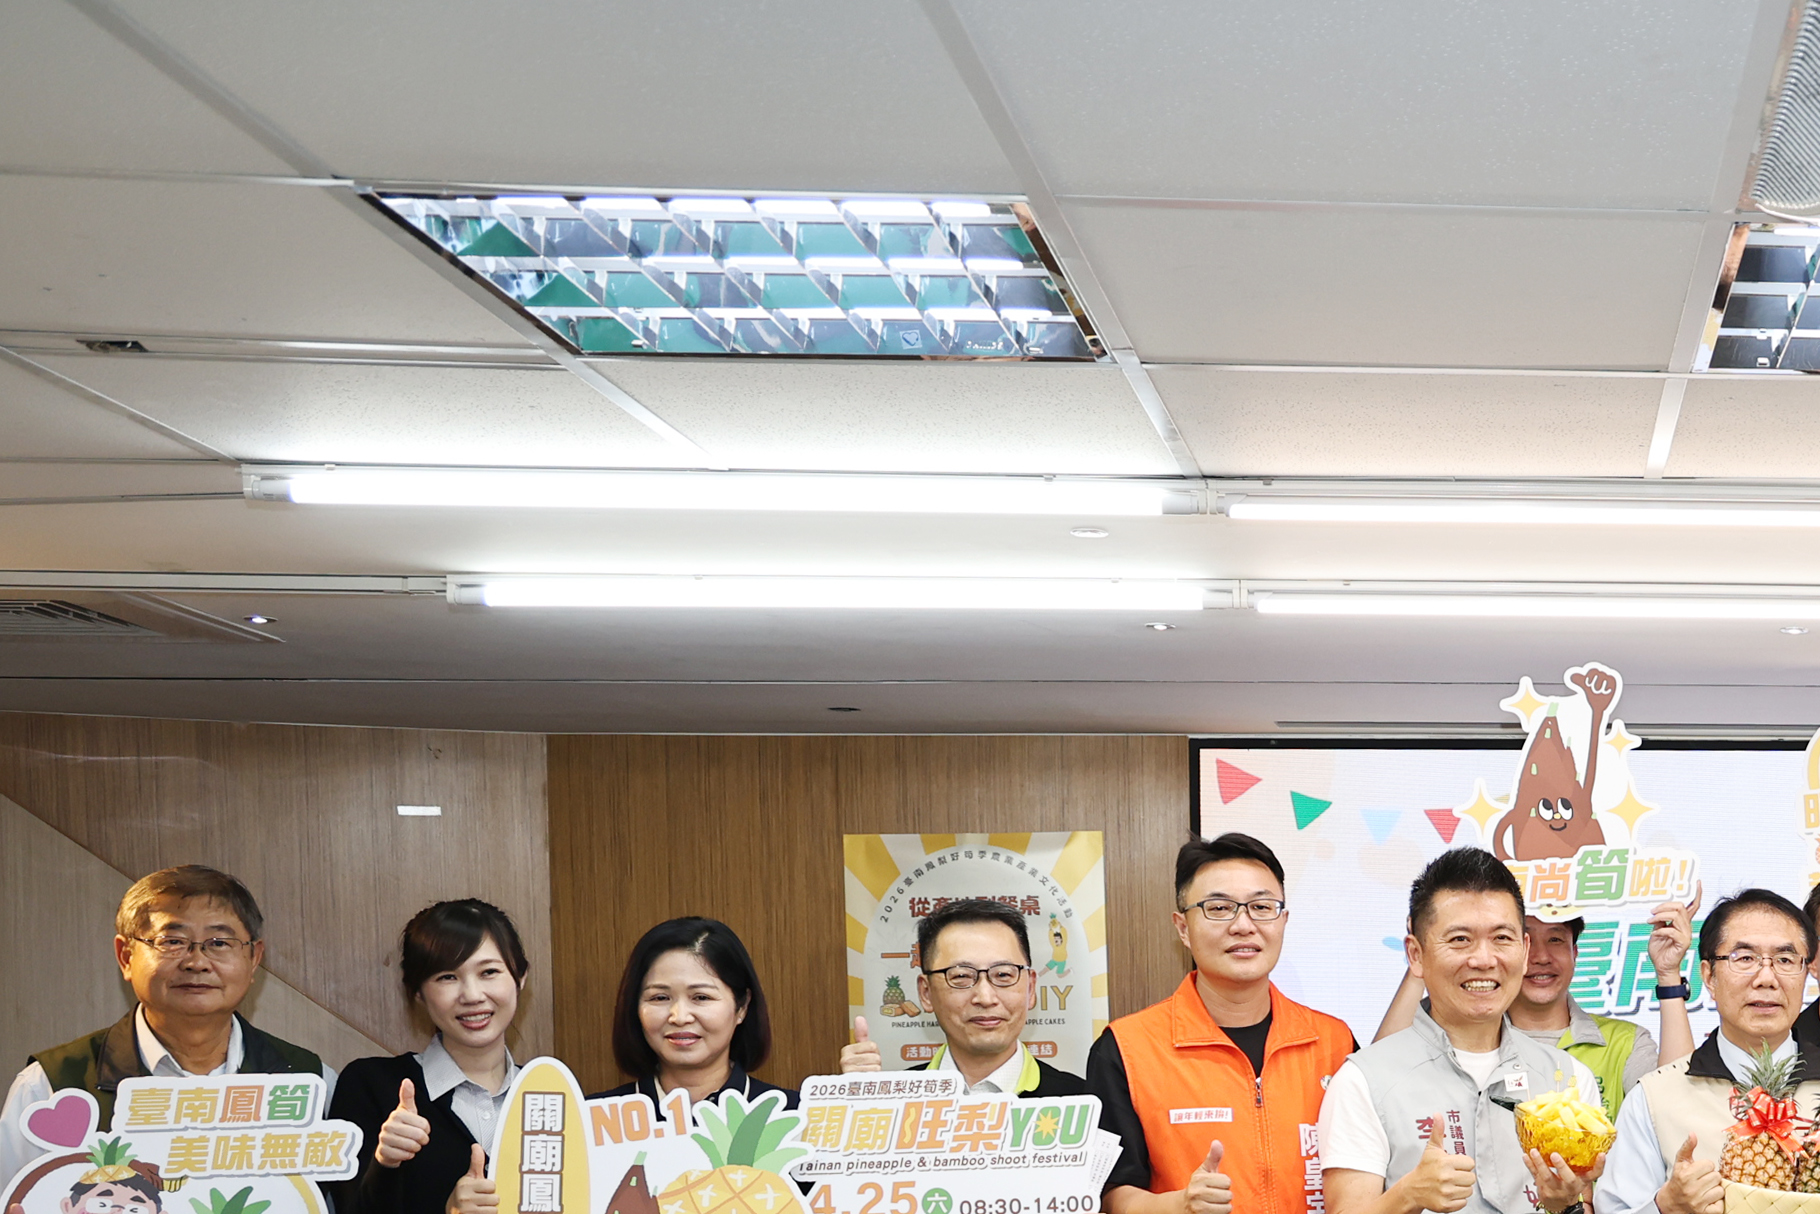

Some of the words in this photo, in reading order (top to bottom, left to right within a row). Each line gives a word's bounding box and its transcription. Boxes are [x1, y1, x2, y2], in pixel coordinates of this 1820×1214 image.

[1029, 984, 1074, 1011] IY
[1044, 1017, 1066, 1026] CAKES
[809, 1078, 954, 1097] 2026臺南鳳梨好筍季
[124, 1084, 312, 1126] 臺南鳳筍
[589, 1094, 688, 1147] NO.1
[1446, 1109, 1467, 1156] 市議員
[164, 1131, 349, 1173] 美味無敵
[846, 1156, 912, 1173] pineapple
[916, 1157, 927, 1168] &
[933, 1154, 985, 1168] bamboo
[990, 1153, 1027, 1166] shoot
[1032, 1151, 1084, 1165] festival
